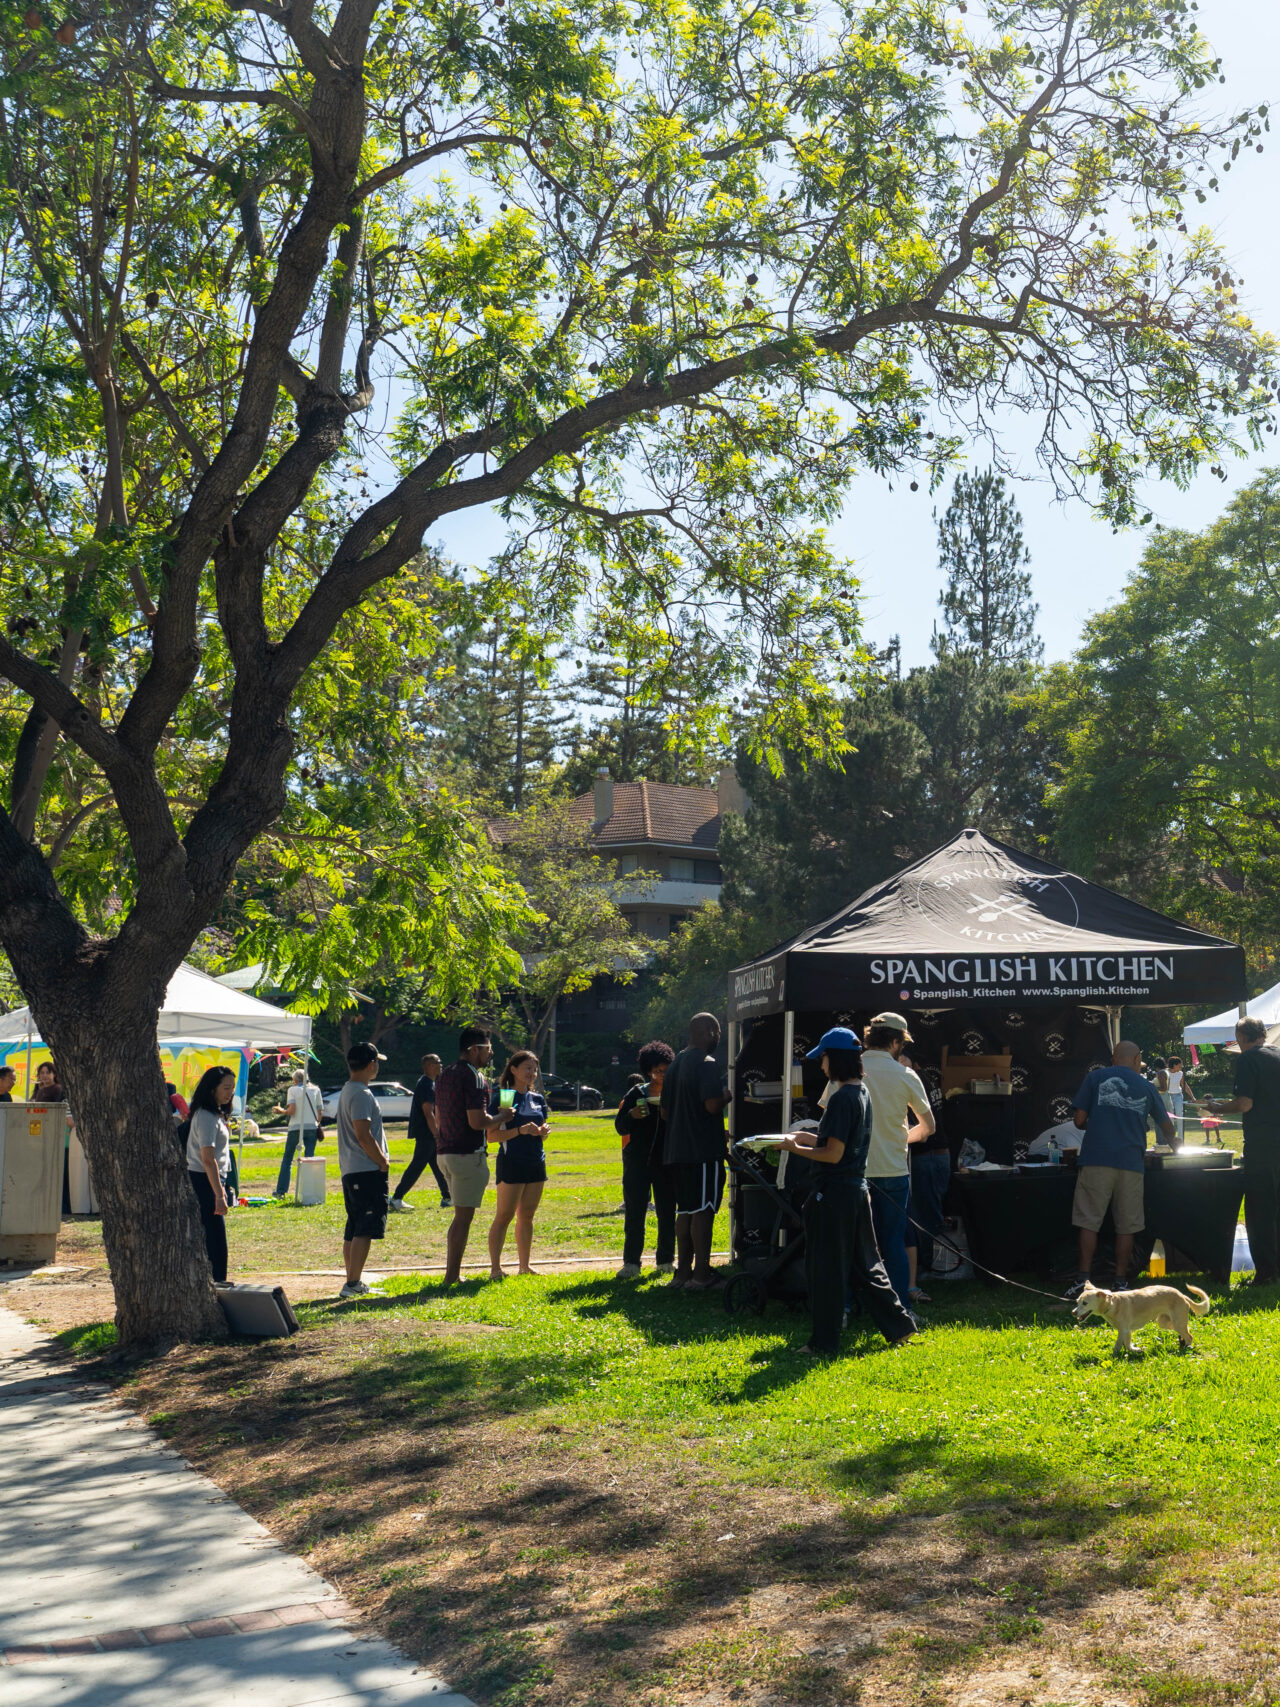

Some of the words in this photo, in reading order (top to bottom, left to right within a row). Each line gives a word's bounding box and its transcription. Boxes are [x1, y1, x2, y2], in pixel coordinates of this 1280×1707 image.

[934, 868, 1049, 893] SPANGLISH
[960, 926, 1056, 943] KITCHEN
[870, 958, 1037, 984] SPANGLISH
[1049, 957, 1174, 981] KITCHEN
[913, 988, 1016, 1000] Spanglish_Kitchen
[1022, 985, 1150, 997] www.Spanglish.Kitchen
